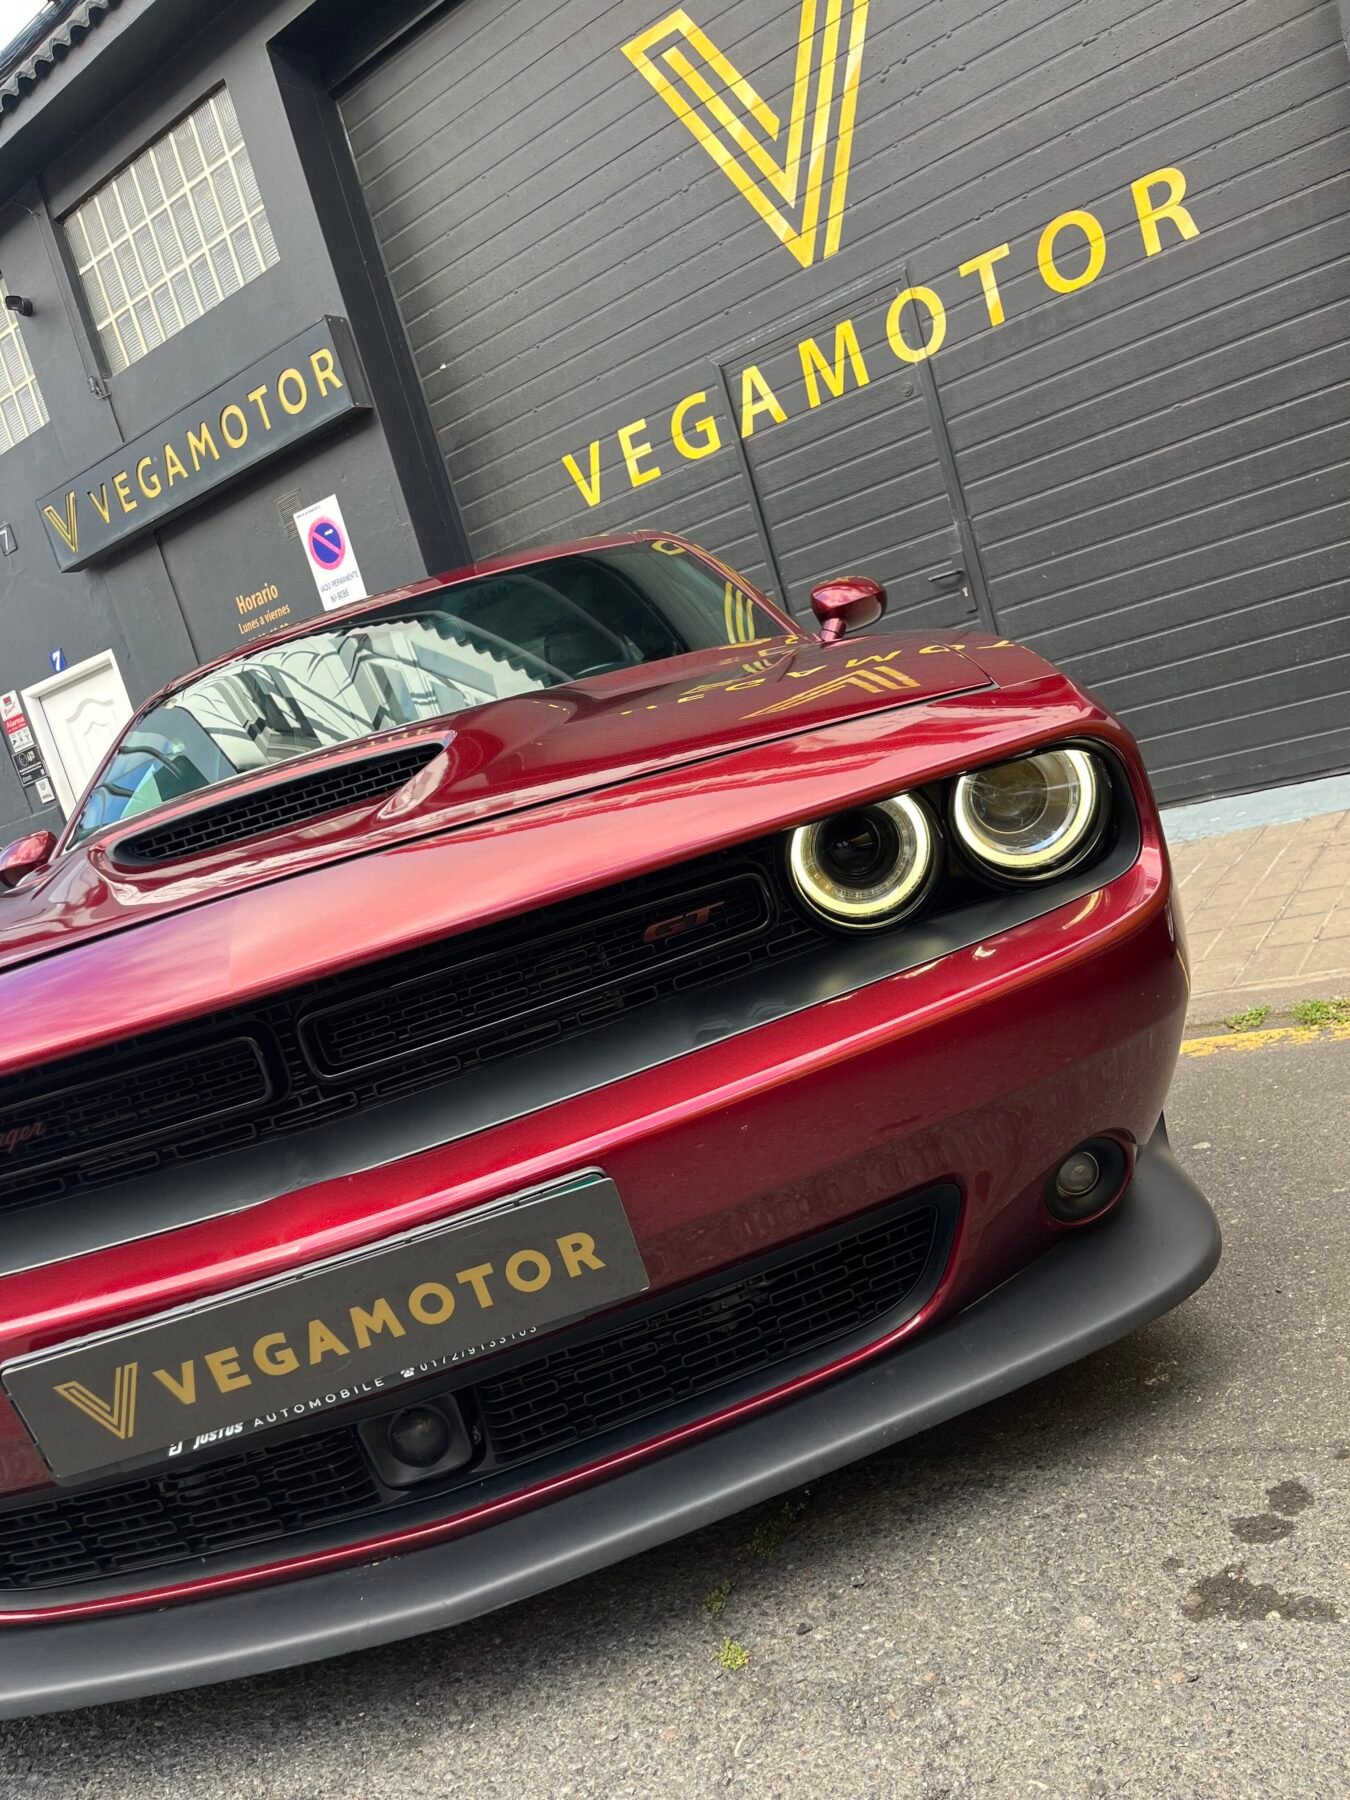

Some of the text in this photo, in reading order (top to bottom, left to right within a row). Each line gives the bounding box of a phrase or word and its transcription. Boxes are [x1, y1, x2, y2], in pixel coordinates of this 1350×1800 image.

[561, 165, 1200, 507] VEGAMOTOR
[87, 347, 343, 525] VEGAMOTOR
[235, 582, 279, 615] Horario
[238, 618, 260, 635] Lunes
[259, 616, 265, 625] a
[264, 604, 291, 623] viernes
[51, 650, 61, 671] 7
[642, 901, 726, 945] GT
[152, 1231, 607, 1406] VEGAMOTOR
[193, 1422, 244, 1450] JUSTUS
[253, 1376, 385, 1428] AUTOMOBILE
